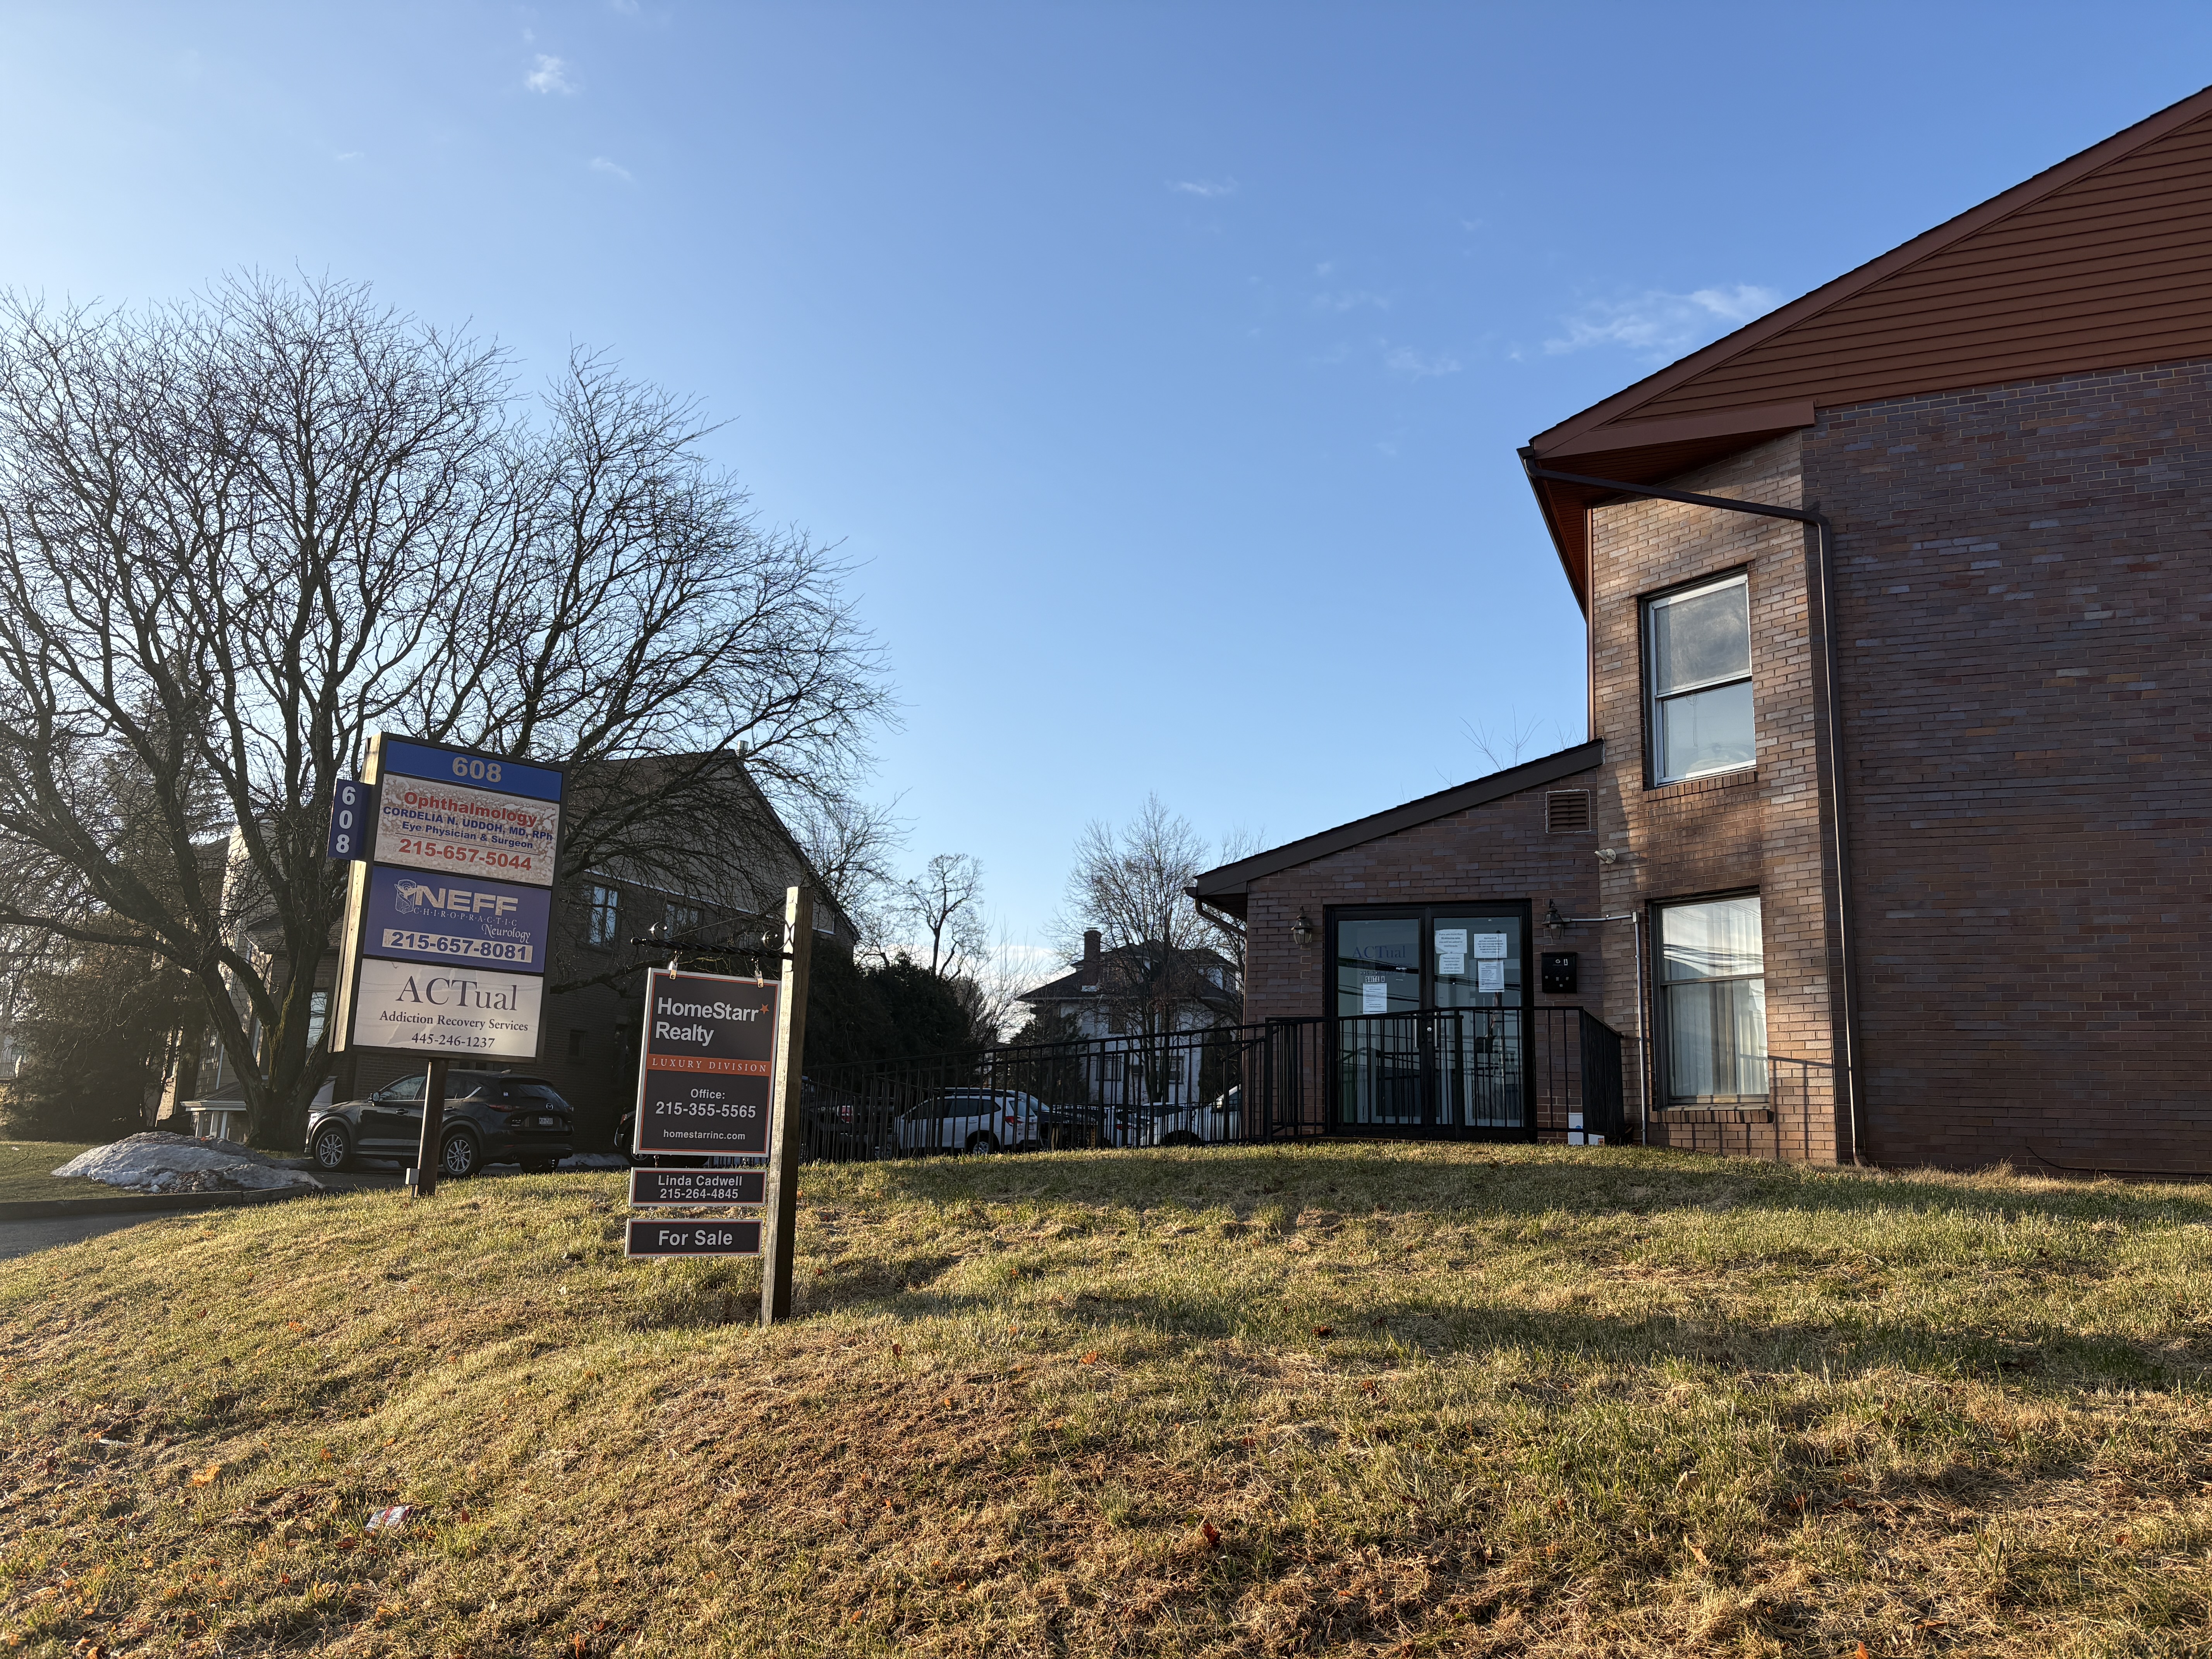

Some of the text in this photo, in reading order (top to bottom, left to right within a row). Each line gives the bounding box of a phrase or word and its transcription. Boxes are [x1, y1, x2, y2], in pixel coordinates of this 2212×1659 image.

[453, 757, 501, 782] 608
[404, 792, 537, 828] Ophthalmology
[383, 806, 553, 842] CORDELIA N. UDDOH, MD, RPh
[402, 821, 533, 849] Eye Physician & Surgeon
[399, 838, 532, 871] 215-657-5044
[415, 885, 518, 916] NEFF
[482, 924, 531, 943] Neurology
[390, 932, 526, 960] 215-657-8081
[1353, 946, 1406, 958] ACTual
[395, 975, 517, 1011] ACTual
[658, 997, 759, 1022] HomeStarr
[379, 1010, 528, 1032] Addiction Recovery Services
[412, 1033, 495, 1048] 445-246-1237
[655, 1021, 714, 1046] Realty
[653, 1058, 766, 1072] LUXURY DIVISION
[690, 1089, 725, 1099] Office:
[655, 1101, 756, 1118] 215-355-5565
[663, 1129, 745, 1140] homestarrinc.com
[658, 1175, 742, 1187] Linda Cadwell
[660, 1188, 738, 1199] 215-264-4845
[658, 1230, 733, 1246] For Sale
